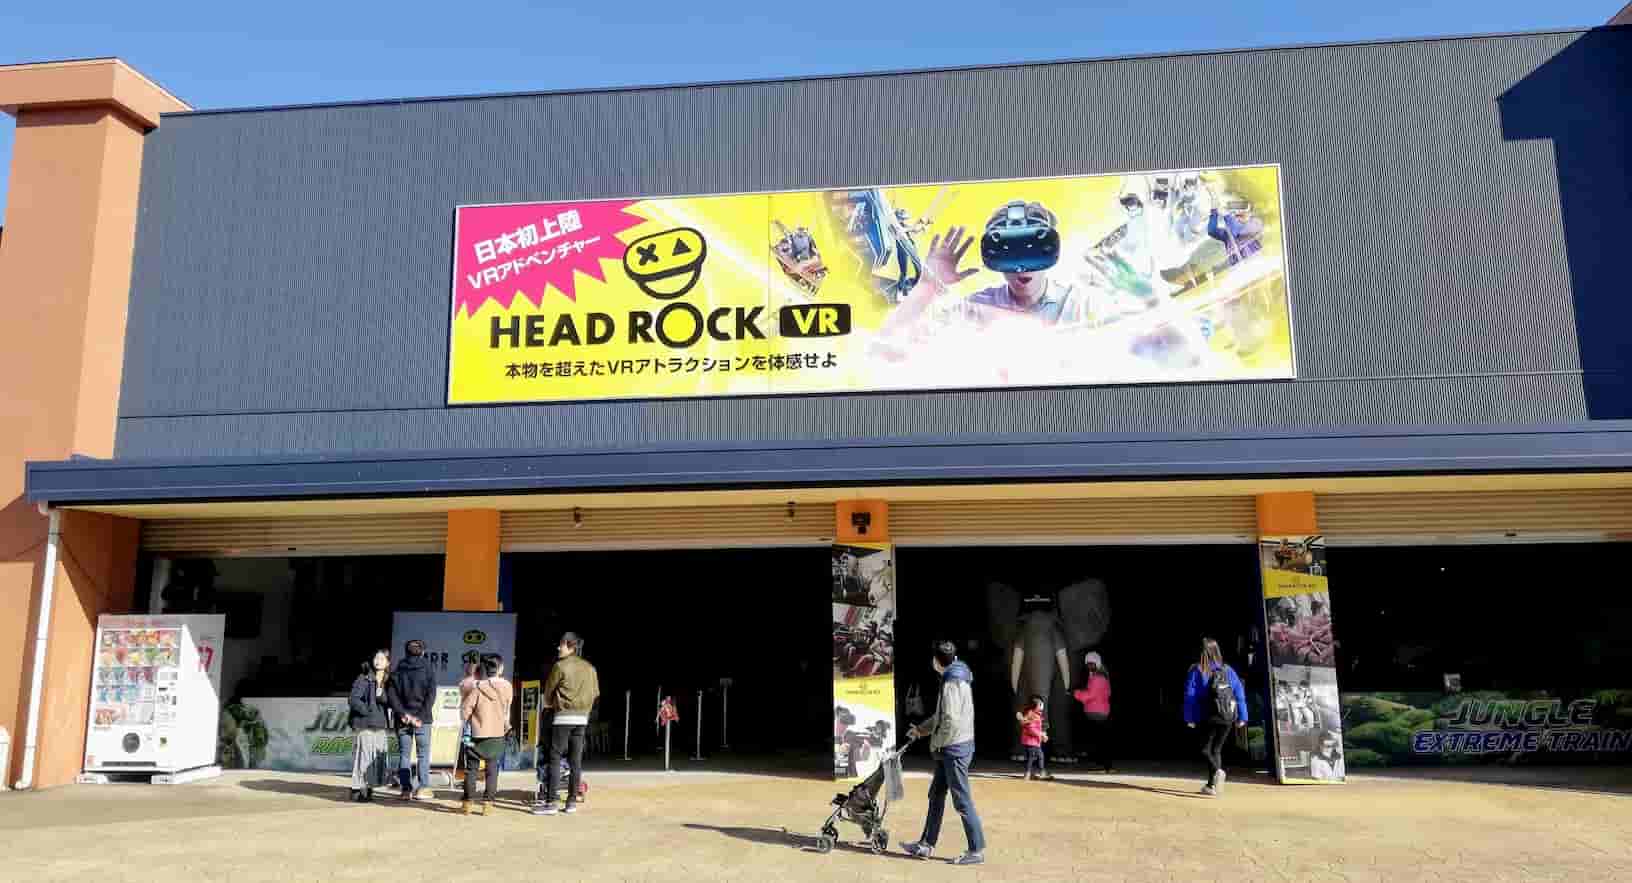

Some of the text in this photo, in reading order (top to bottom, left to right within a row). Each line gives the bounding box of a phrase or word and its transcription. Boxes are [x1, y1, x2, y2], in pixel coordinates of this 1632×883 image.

[474, 209, 583, 264] 日本初上陸
[467, 235, 601, 289] VRアドベンチャー
[489, 302, 841, 349] HEAD ROCK VR
[504, 352, 838, 379] 本物を超えたVRアトラクションを体感せよ
[1449, 699, 1598, 727] JUNGLE
[1413, 731, 1538, 752] EXTREME
